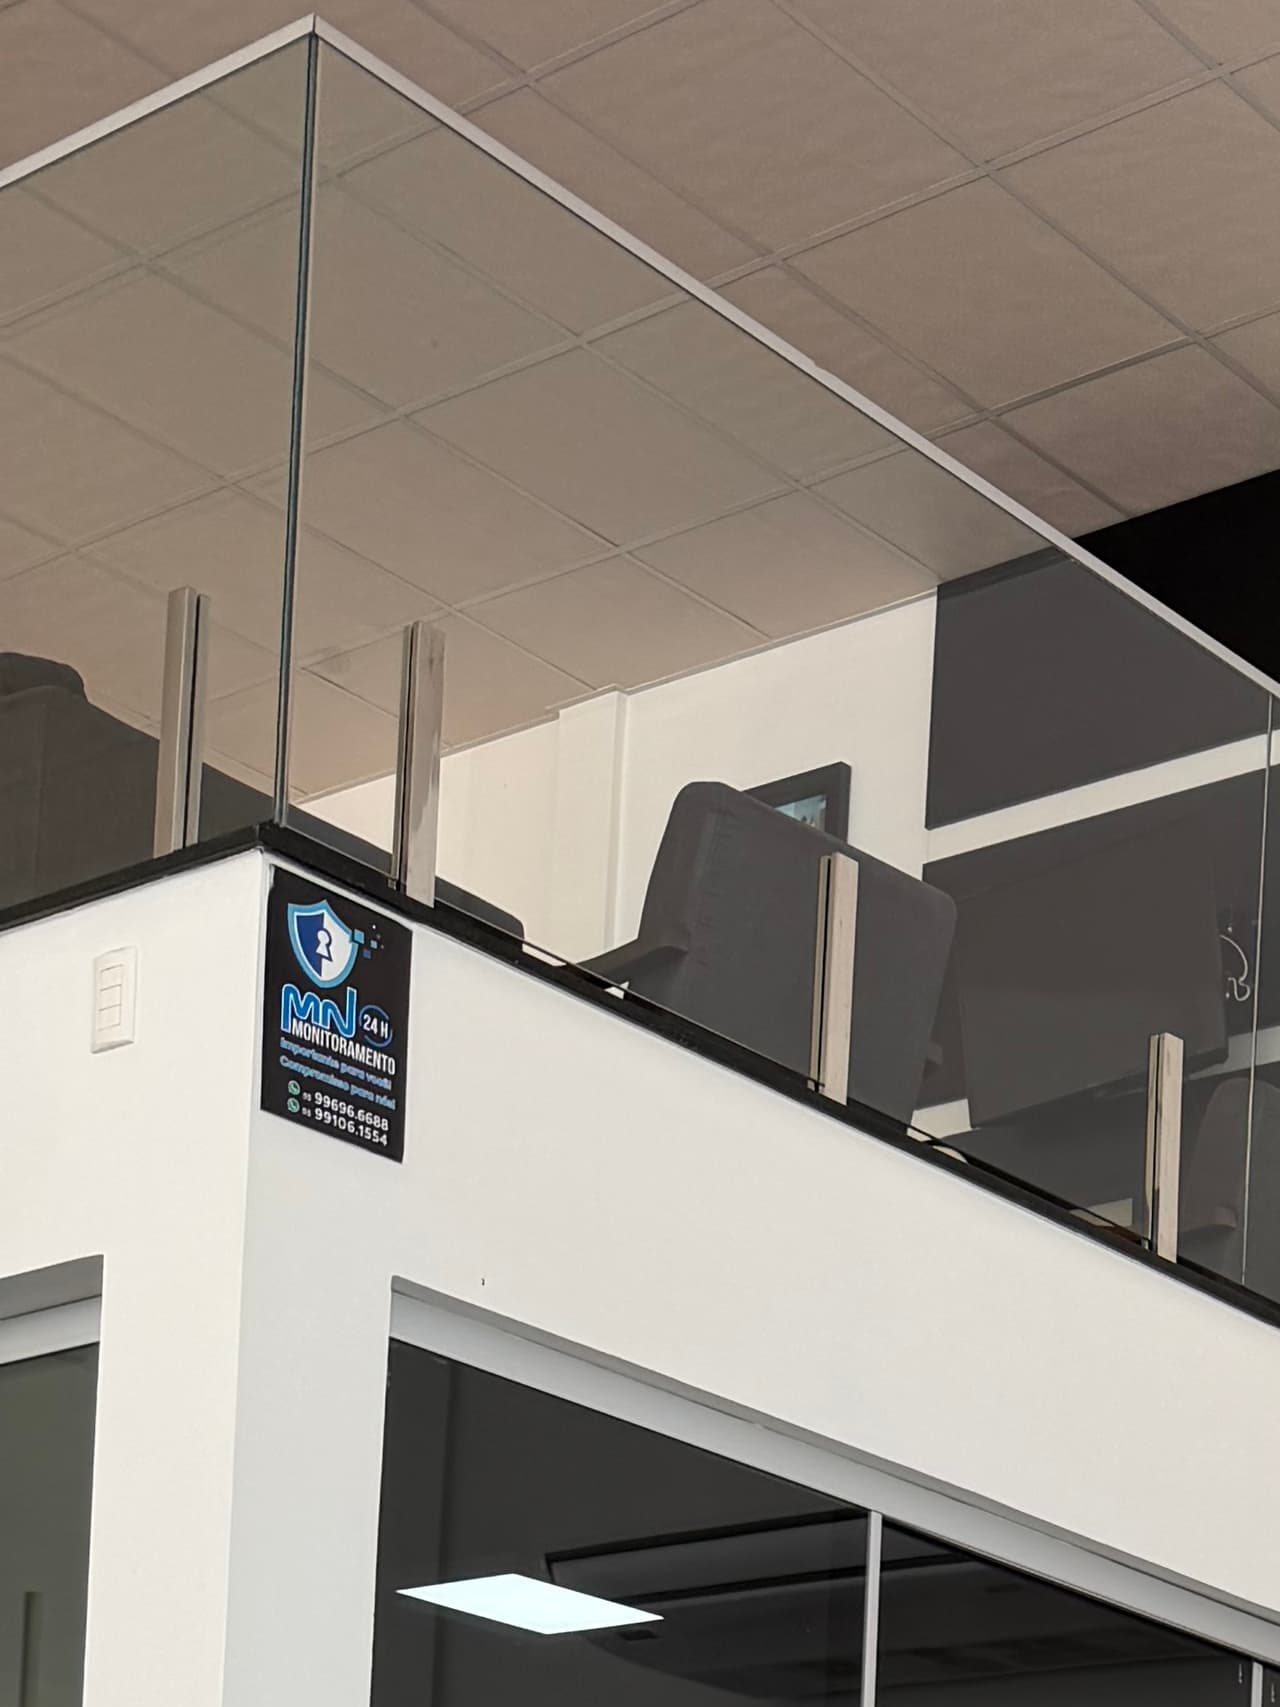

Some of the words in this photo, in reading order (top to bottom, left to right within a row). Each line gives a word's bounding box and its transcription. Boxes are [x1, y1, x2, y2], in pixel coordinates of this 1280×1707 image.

[281, 983, 357, 1038] MN
[363, 1013, 378, 1035] 24
[380, 1021, 389, 1039] H
[291, 1018, 396, 1075] MONITORAMENTO
[314, 1091, 389, 1131] 99696.6688
[314, 1107, 388, 1147] 99106.1554
